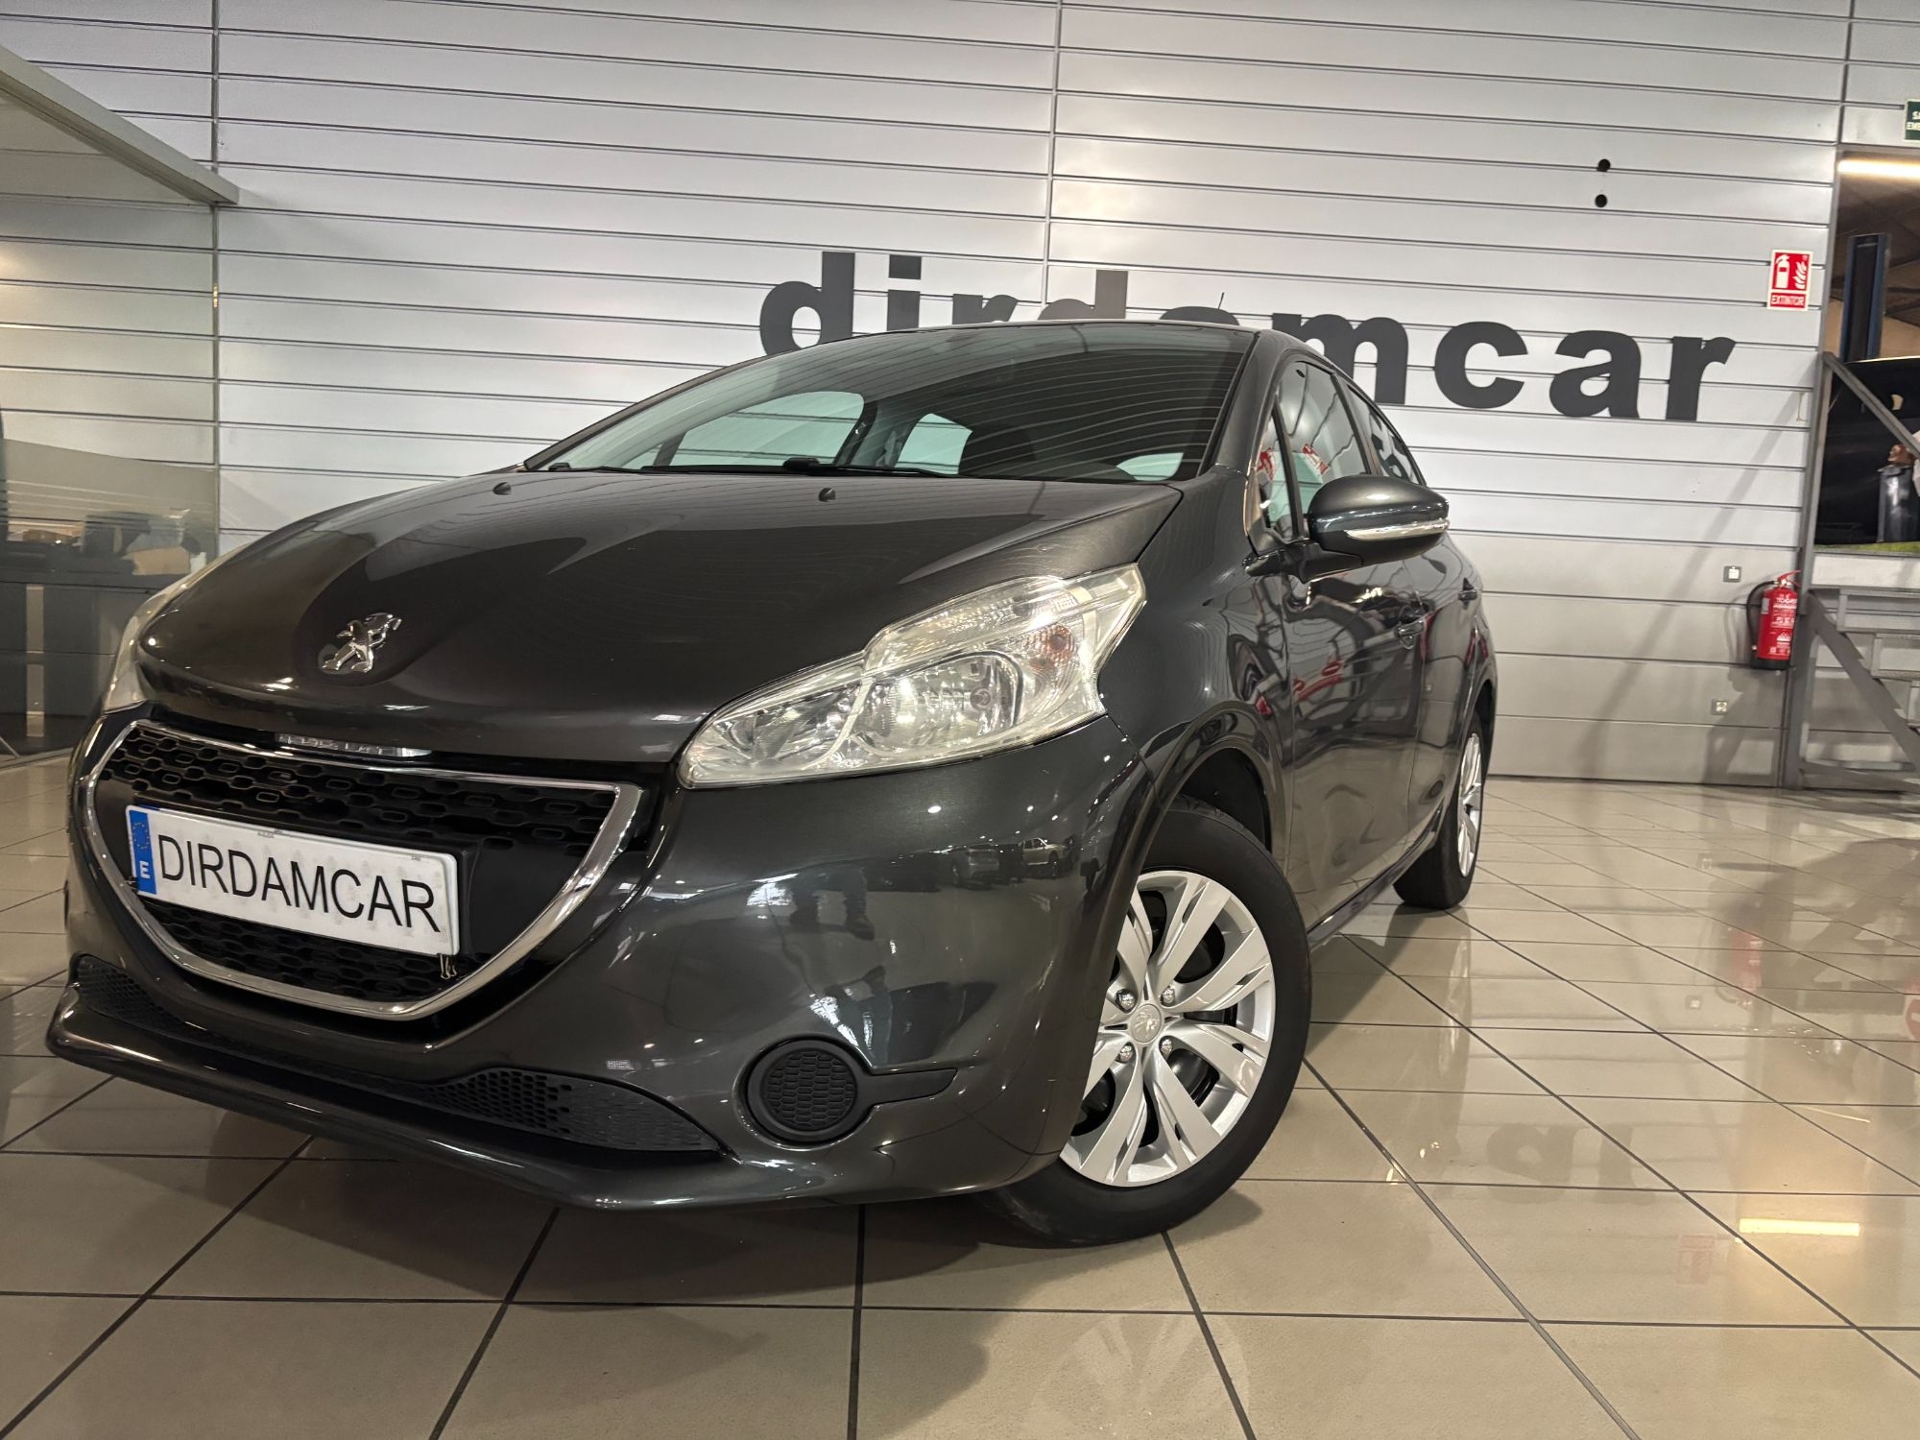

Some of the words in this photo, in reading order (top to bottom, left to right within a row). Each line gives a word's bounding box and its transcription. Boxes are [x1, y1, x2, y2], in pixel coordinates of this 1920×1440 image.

[759, 251, 1735, 422] dimcar
[139, 860, 150, 879] E
[158, 834, 441, 932] DIRDAMCAR
